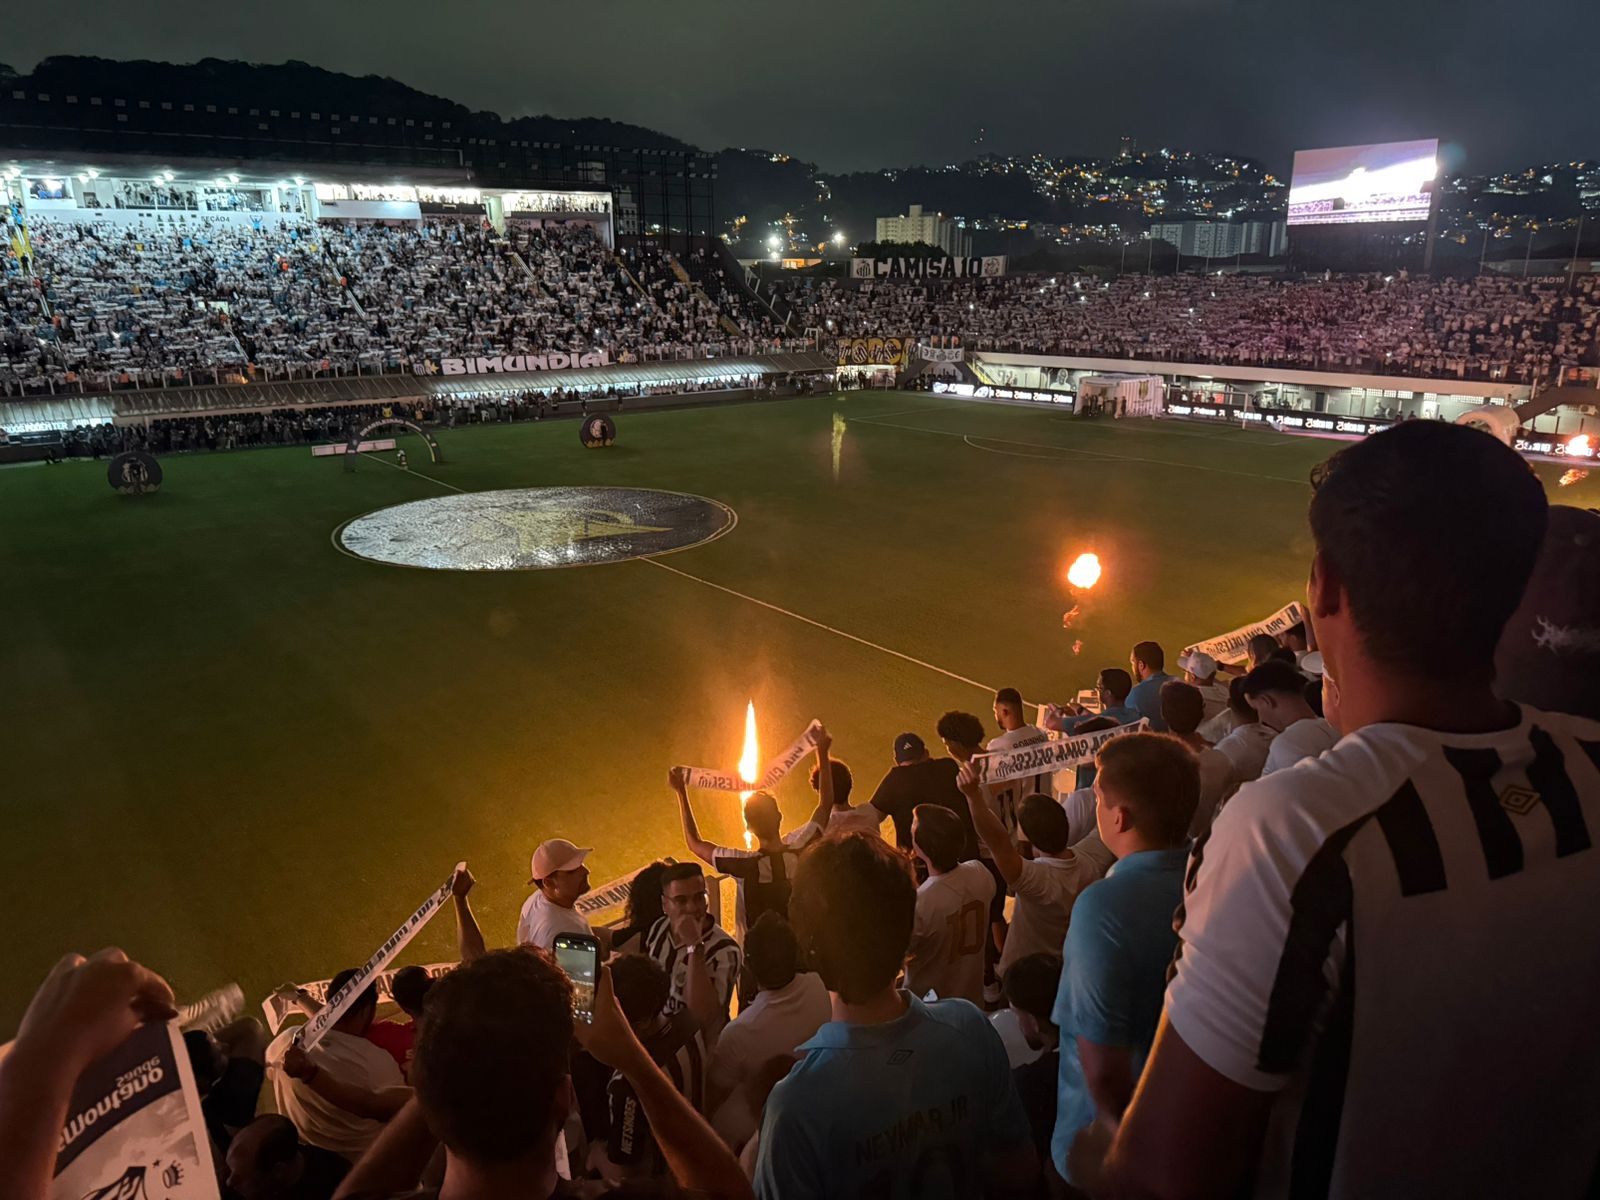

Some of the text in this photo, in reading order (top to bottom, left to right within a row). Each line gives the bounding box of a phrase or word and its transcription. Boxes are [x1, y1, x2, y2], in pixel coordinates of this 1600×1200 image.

[873, 256, 983, 279] CAMISA 10
[440, 352, 615, 376] BIMUNDIAL
[945, 899, 985, 962] 10
[855, 1107, 945, 1168] NEYMAR
